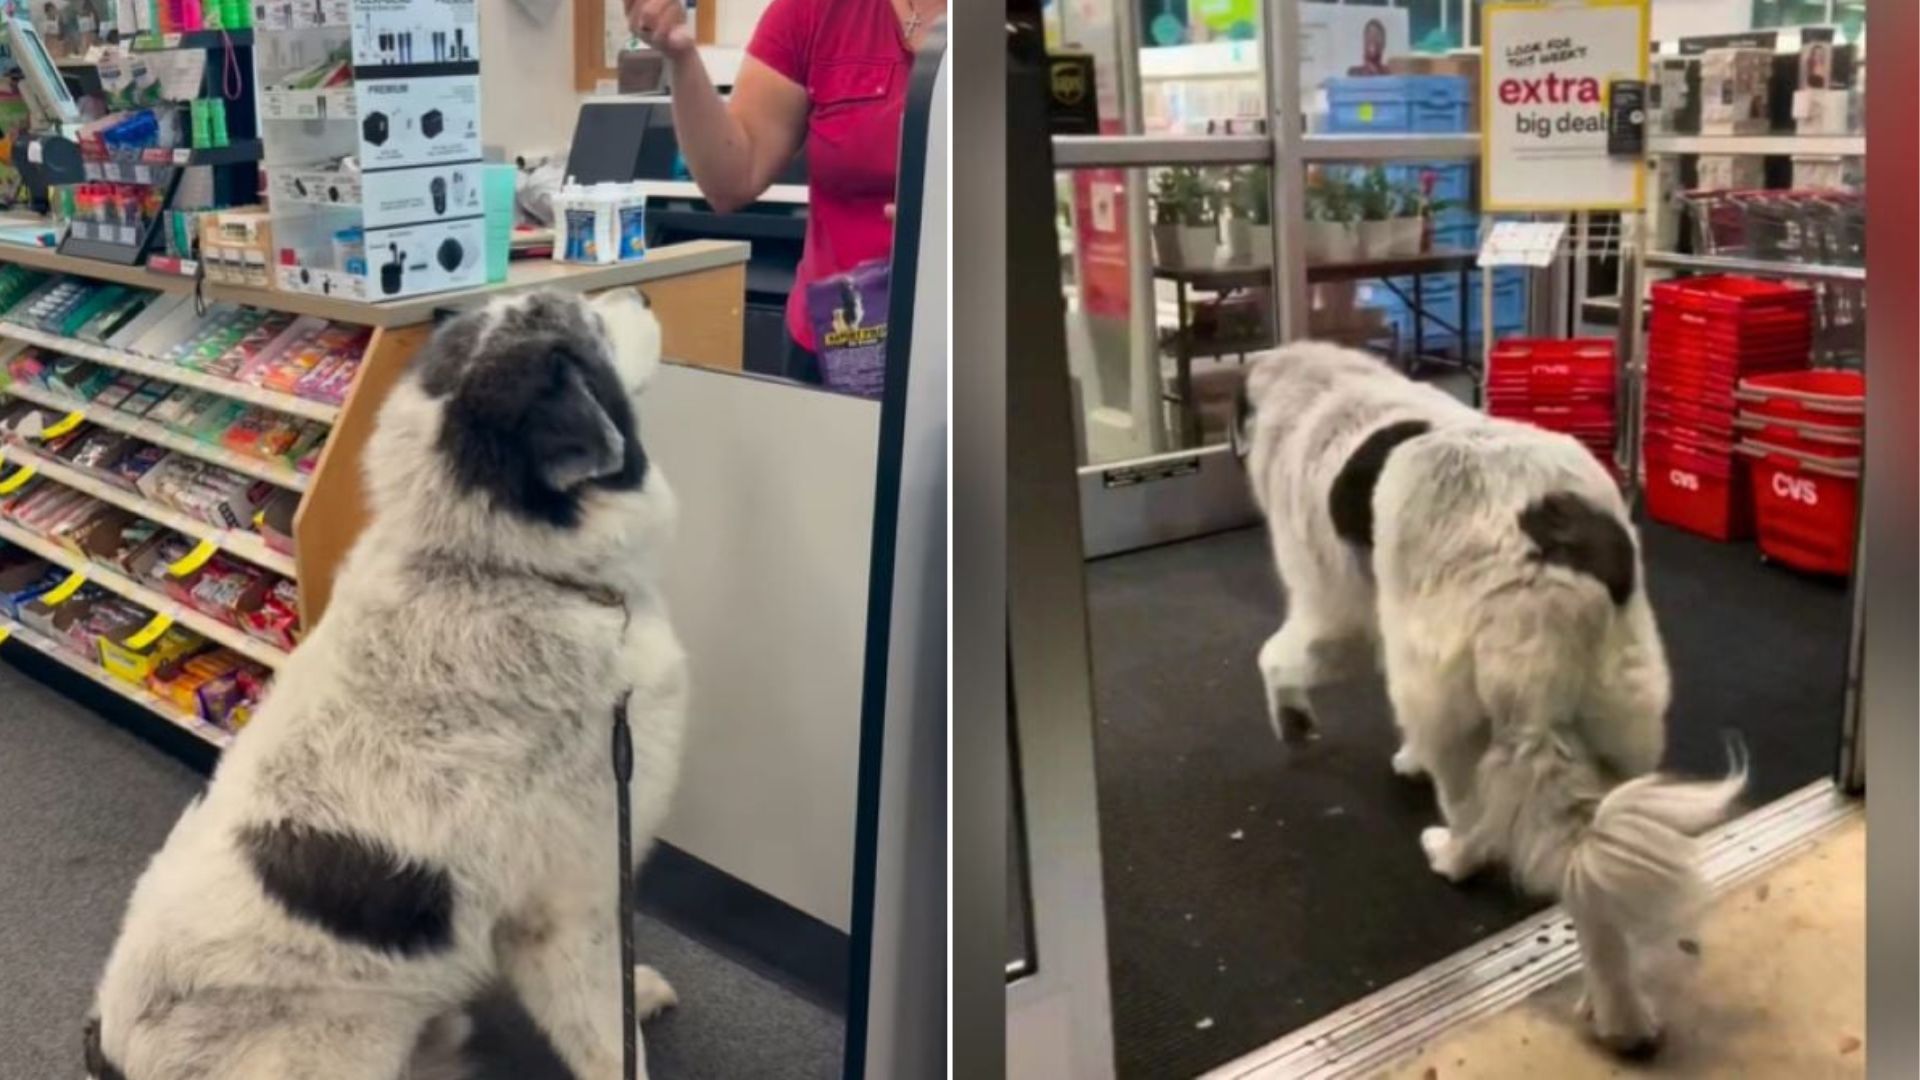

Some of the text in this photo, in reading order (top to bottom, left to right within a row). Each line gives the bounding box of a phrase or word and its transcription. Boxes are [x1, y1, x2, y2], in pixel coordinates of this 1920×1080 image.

[368, 84, 409, 94] PREMIUM
[1499, 72, 1600, 104] extra
[1516, 112, 1610, 138] big deal
[1669, 469, 1700, 491] CVS
[1772, 472, 1818, 506] CVS
